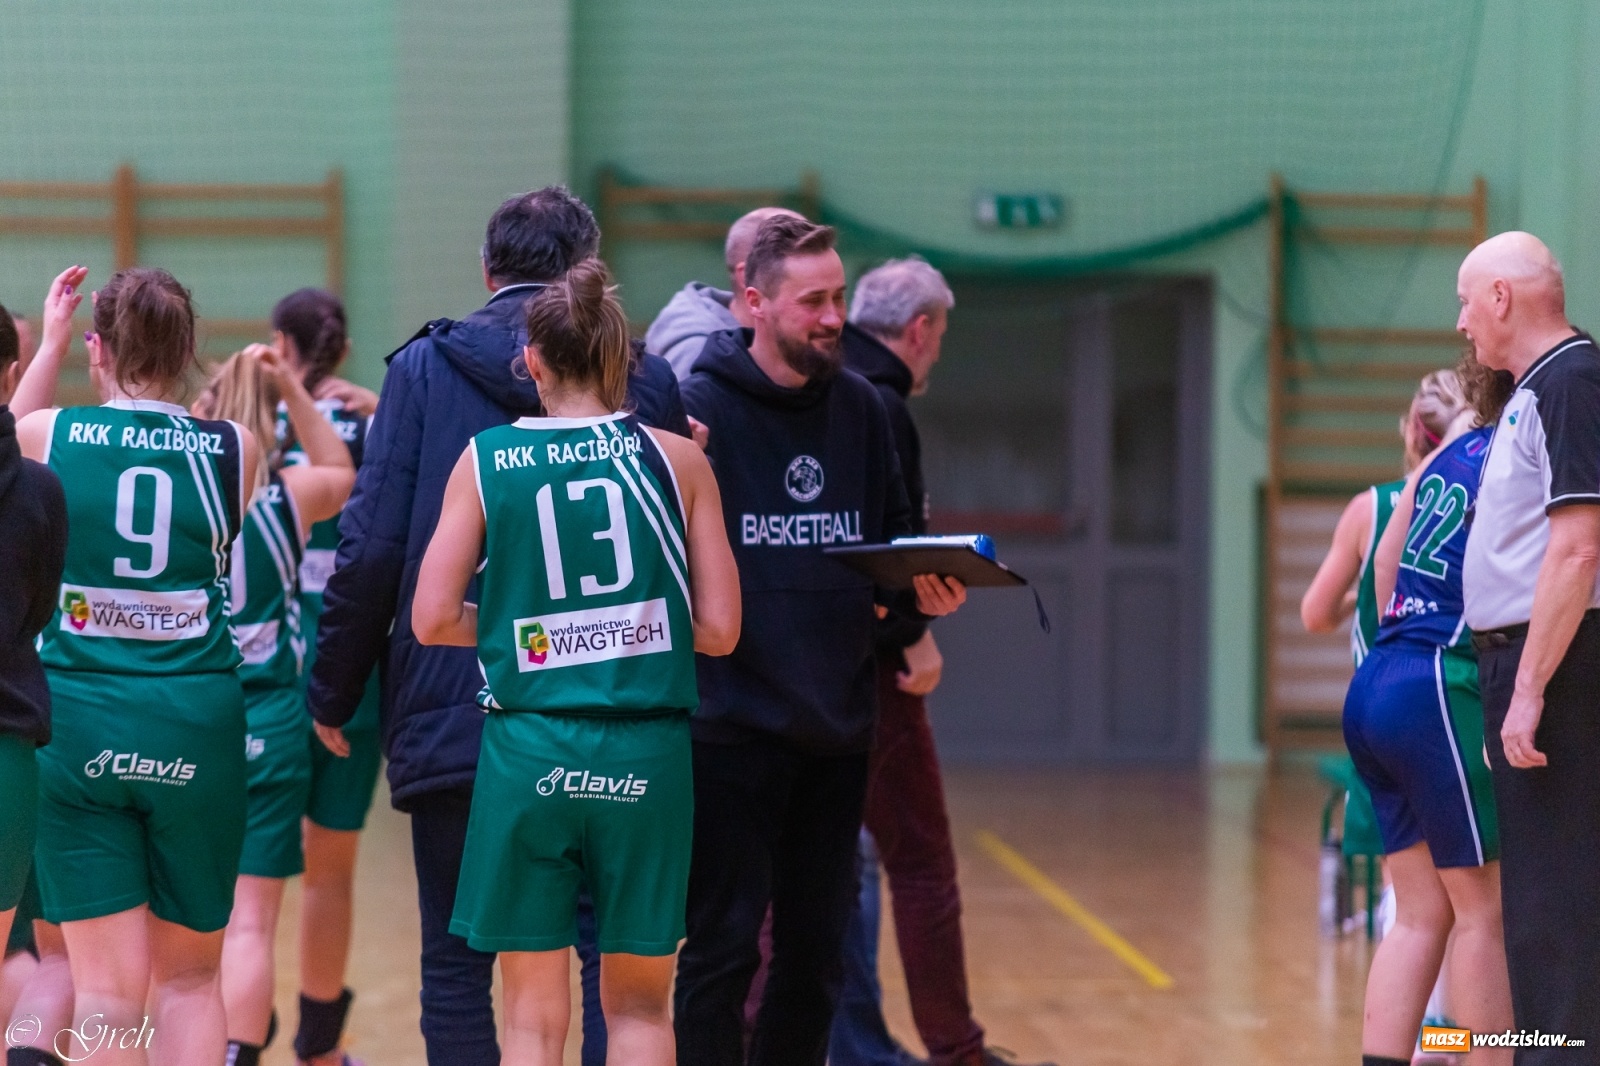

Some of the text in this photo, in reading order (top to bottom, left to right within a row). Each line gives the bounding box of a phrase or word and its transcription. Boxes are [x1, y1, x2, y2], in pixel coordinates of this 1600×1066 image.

[68, 422, 224, 454] RKK RACIBÓRZ
[494, 445, 536, 471] RKK
[113, 466, 173, 579] 9
[742, 511, 863, 545] BASKETBALL
[1399, 473, 1468, 580] 22
[536, 477, 634, 600] 13
[92, 599, 172, 614] wydawnictwo
[93, 607, 202, 631] WAGTECH
[549, 618, 632, 637] wydawnictwo
[551, 621, 665, 656] WAGTECH
[112, 753, 197, 780] Clavis
[563, 770, 649, 796] Clavis
[613, 795, 639, 803] KLUCZY
